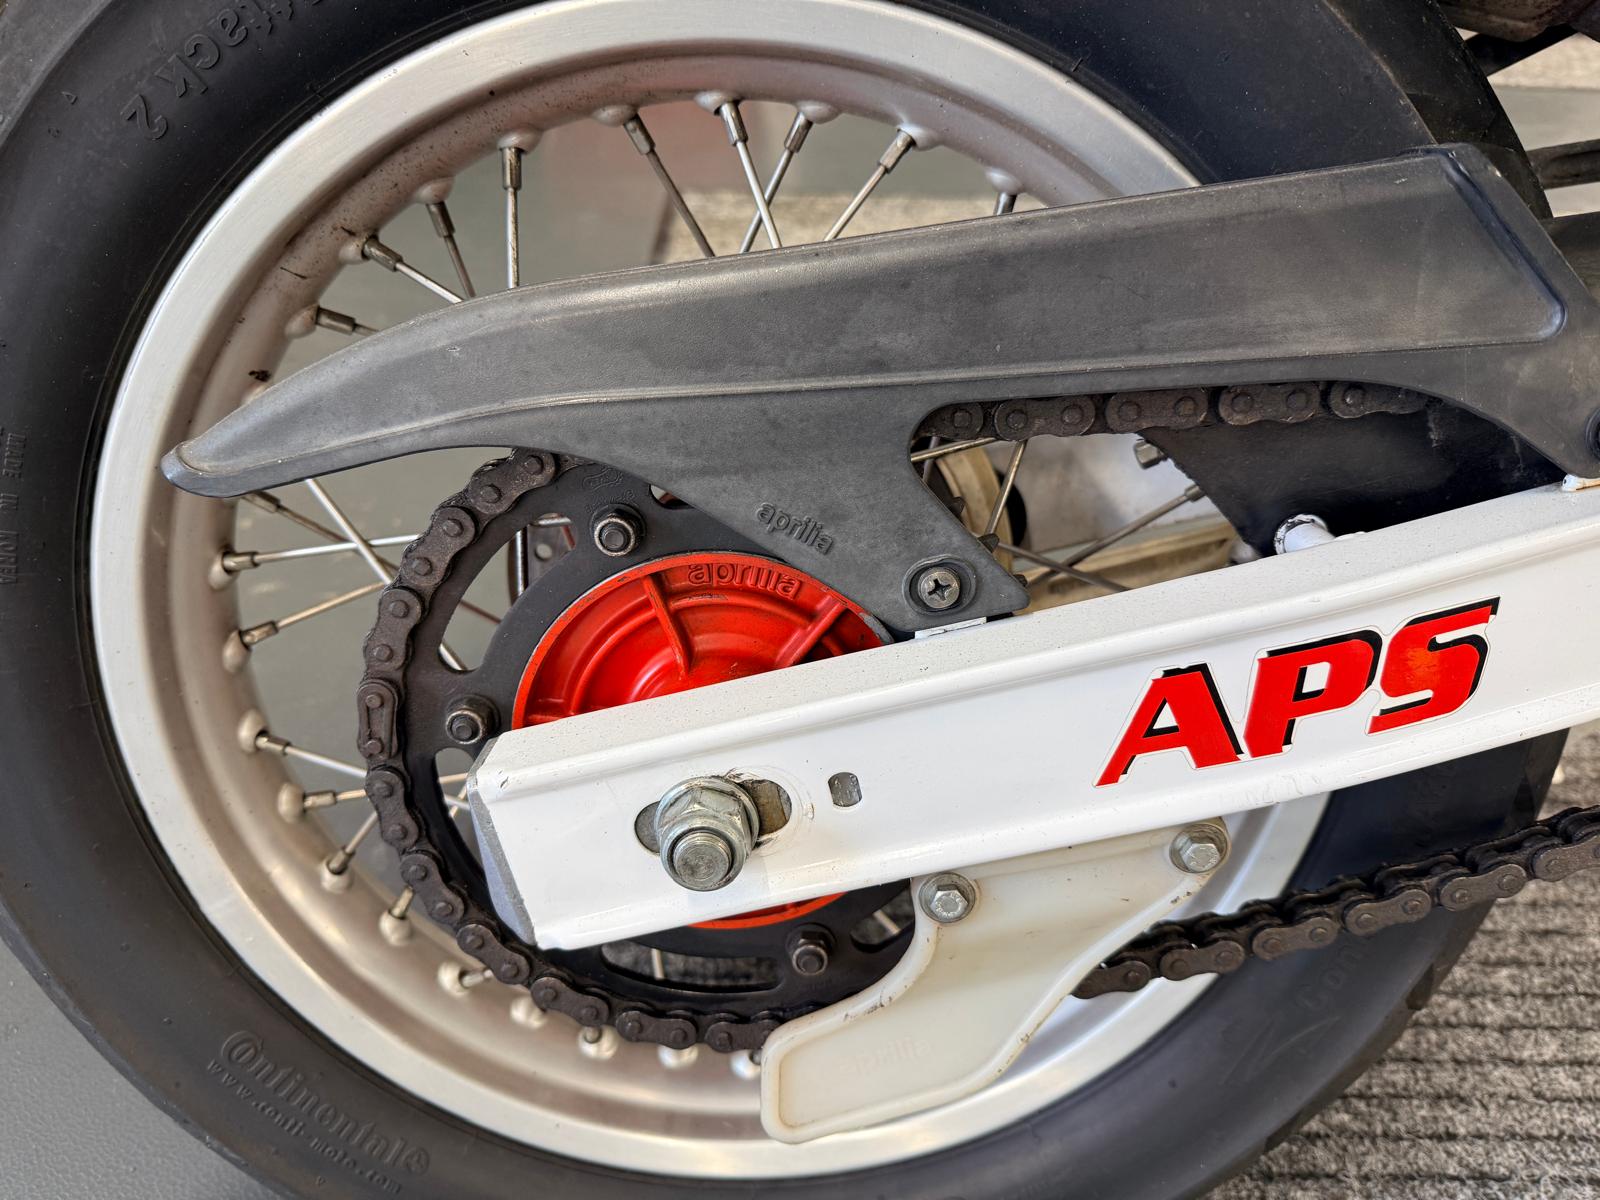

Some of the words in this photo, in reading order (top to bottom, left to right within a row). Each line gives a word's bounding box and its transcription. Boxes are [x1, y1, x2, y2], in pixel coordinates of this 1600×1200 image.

[120, 93, 168, 141] 2
[3, 432, 26, 479] MADE
[0, 493, 18, 511] IN
[756, 502, 833, 556] aprilia
[0, 531, 18, 584] KOREA
[688, 563, 802, 600] aprilia
[1096, 597, 1500, 787] APS
[219, 1030, 408, 1168] Continental
